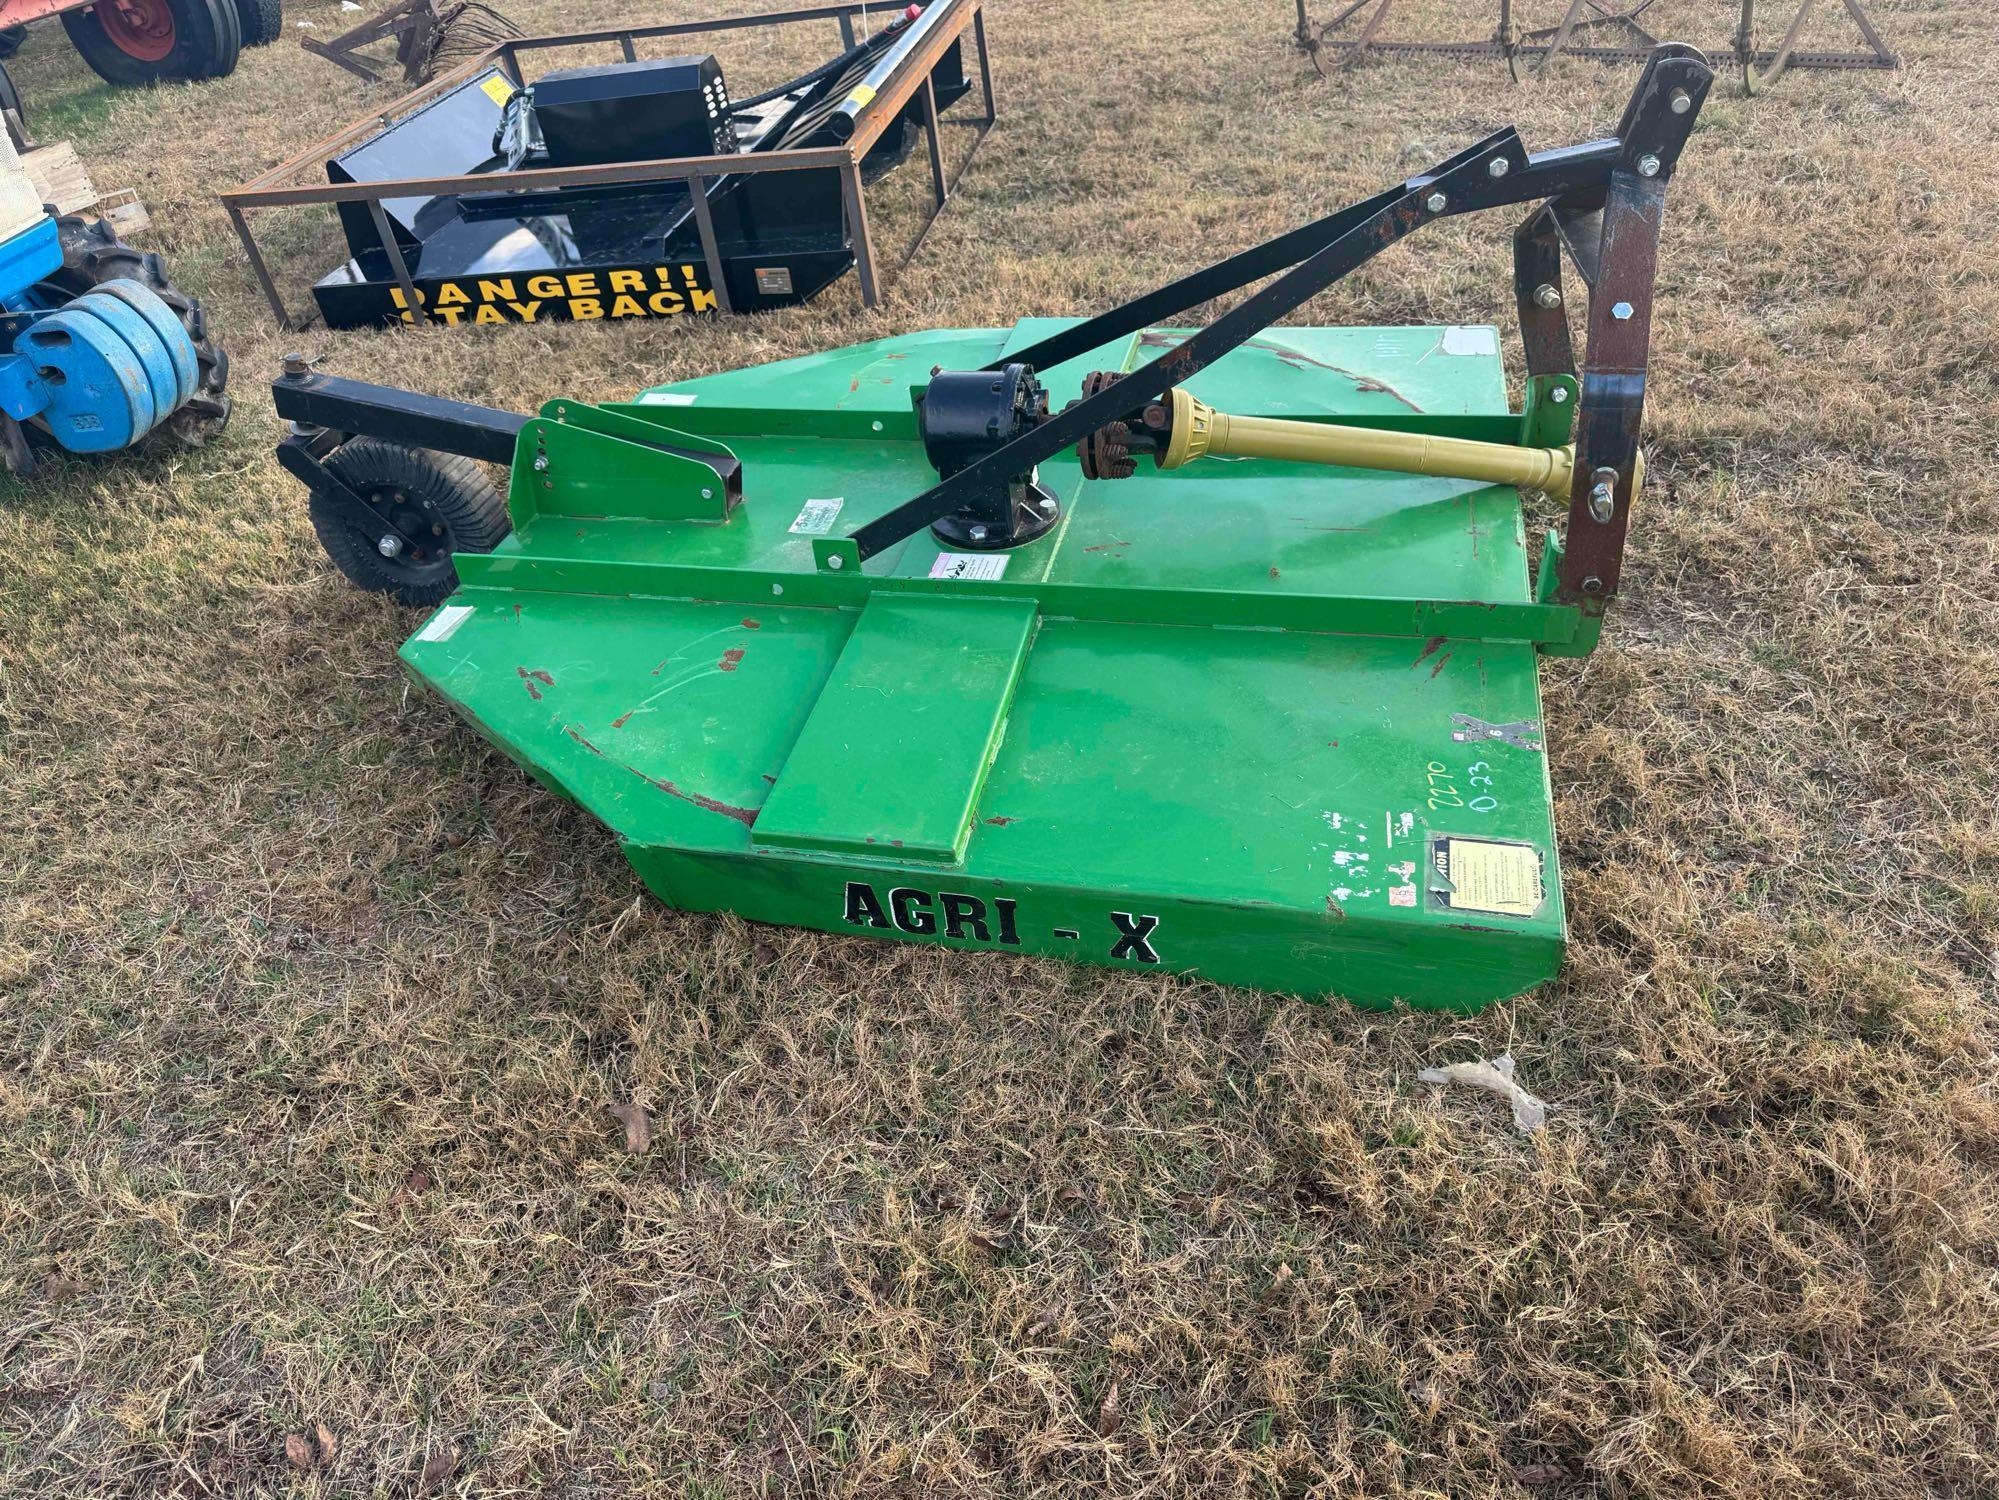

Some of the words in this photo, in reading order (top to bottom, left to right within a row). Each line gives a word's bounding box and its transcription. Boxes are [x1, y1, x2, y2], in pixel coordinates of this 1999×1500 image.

[390, 265, 698, 308] DANGER!!
[568, 289, 718, 320] BACK
[1427, 761, 1464, 811] 2270
[843, 881, 1022, 945] AGRI
[1053, 927, 1079, 940] -
[1110, 911, 1161, 965] X
